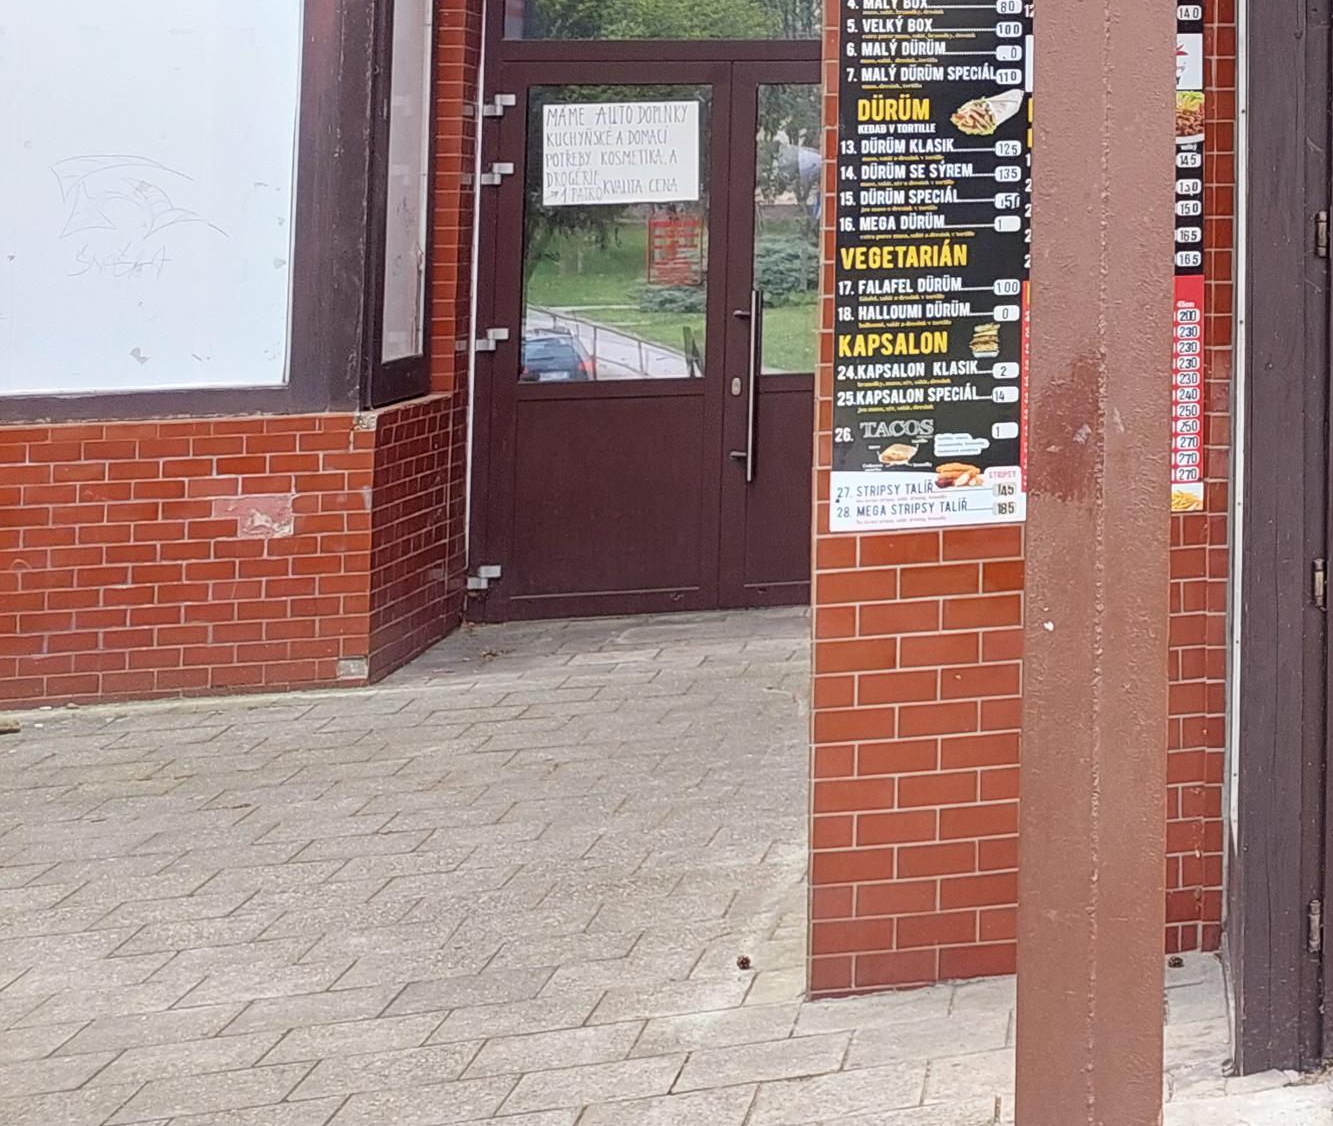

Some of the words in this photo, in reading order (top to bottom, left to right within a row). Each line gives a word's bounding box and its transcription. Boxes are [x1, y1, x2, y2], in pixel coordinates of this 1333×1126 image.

[1000, 0, 1014, 12] 80
[1179, 8, 1199, 19] 140
[847, 19, 858, 32] 5.
[862, 16, 903, 33] VELKÝ
[908, 19, 933, 32] BOX
[999, 24, 1019, 35] 100
[846, 42, 857, 56] 6.
[862, 39, 897, 56] MALÝ
[902, 38, 945, 56] DÜRÜM
[846, 69, 857, 82] 7.
[861, 64, 896, 81] MALÝ
[901, 65, 944, 81] DÜRÜM
[857, 94, 930, 121] DÜRÜM
[546, 107, 585, 127] MÁME
[595, 106, 633, 125] AUTO
[858, 124, 886, 134] KEBAB
[888, 124, 895, 133] V
[897, 123, 936, 134] TORTILLE
[616, 131, 624, 145] A
[841, 140, 856, 154] 13.
[861, 137, 904, 153] DÜRÜM
[909, 139, 954, 153] KLASIK
[1000, 143, 1018, 155] 125
[669, 149, 678, 164] A
[1180, 154, 1196, 165] 145
[840, 166, 857, 180] 14.
[861, 163, 904, 179] DÜRÜM
[909, 164, 925, 178] SE
[929, 161, 973, 178] SÝREM
[1000, 169, 1017, 180] 135
[649, 178, 678, 194] CENA
[840, 192, 856, 206] 15.
[860, 188, 904, 205] DÜRÜM
[1180, 203, 1199, 214] 150
[839, 218, 855, 231] 16.
[860, 217, 896, 231] MEGA
[901, 213, 945, 230] DÜRÜM
[1180, 231, 1197, 241] 165
[840, 239, 968, 270] VEGETARIÁN
[1180, 254, 1198, 264] 165
[838, 281, 854, 295] 17.
[859, 280, 913, 294] FALAFEL
[917, 275, 962, 292] DÜRÜM
[838, 307, 854, 321] 18.
[858, 304, 922, 320] HALLOUMI
[926, 301, 970, 318] DÜRÜM
[1179, 311, 1197, 321] 200
[1179, 327, 1197, 337] 230
[838, 331, 948, 358] KAPSALON
[1179, 342, 1197, 352] 230
[933, 360, 978, 376] KLASIK
[1179, 358, 1197, 368] 230
[1179, 373, 1197, 384] 230
[1179, 389, 1197, 400] 240
[1179, 405, 1197, 416] 250
[835, 428, 853, 442] 26.
[860, 419, 934, 439] TACOS
[1179, 420, 1197, 432] 250
[1179, 436, 1197, 447] 270
[1179, 453, 1197, 464] 270
[1179, 469, 1197, 480] 270
[856, 484, 901, 497] STRIPSY
[905, 479, 933, 494] TALÍŘ
[856, 504, 887, 517] MEGA
[891, 502, 935, 515] STRIPSY
[940, 497, 967, 512] TALÍŘ
